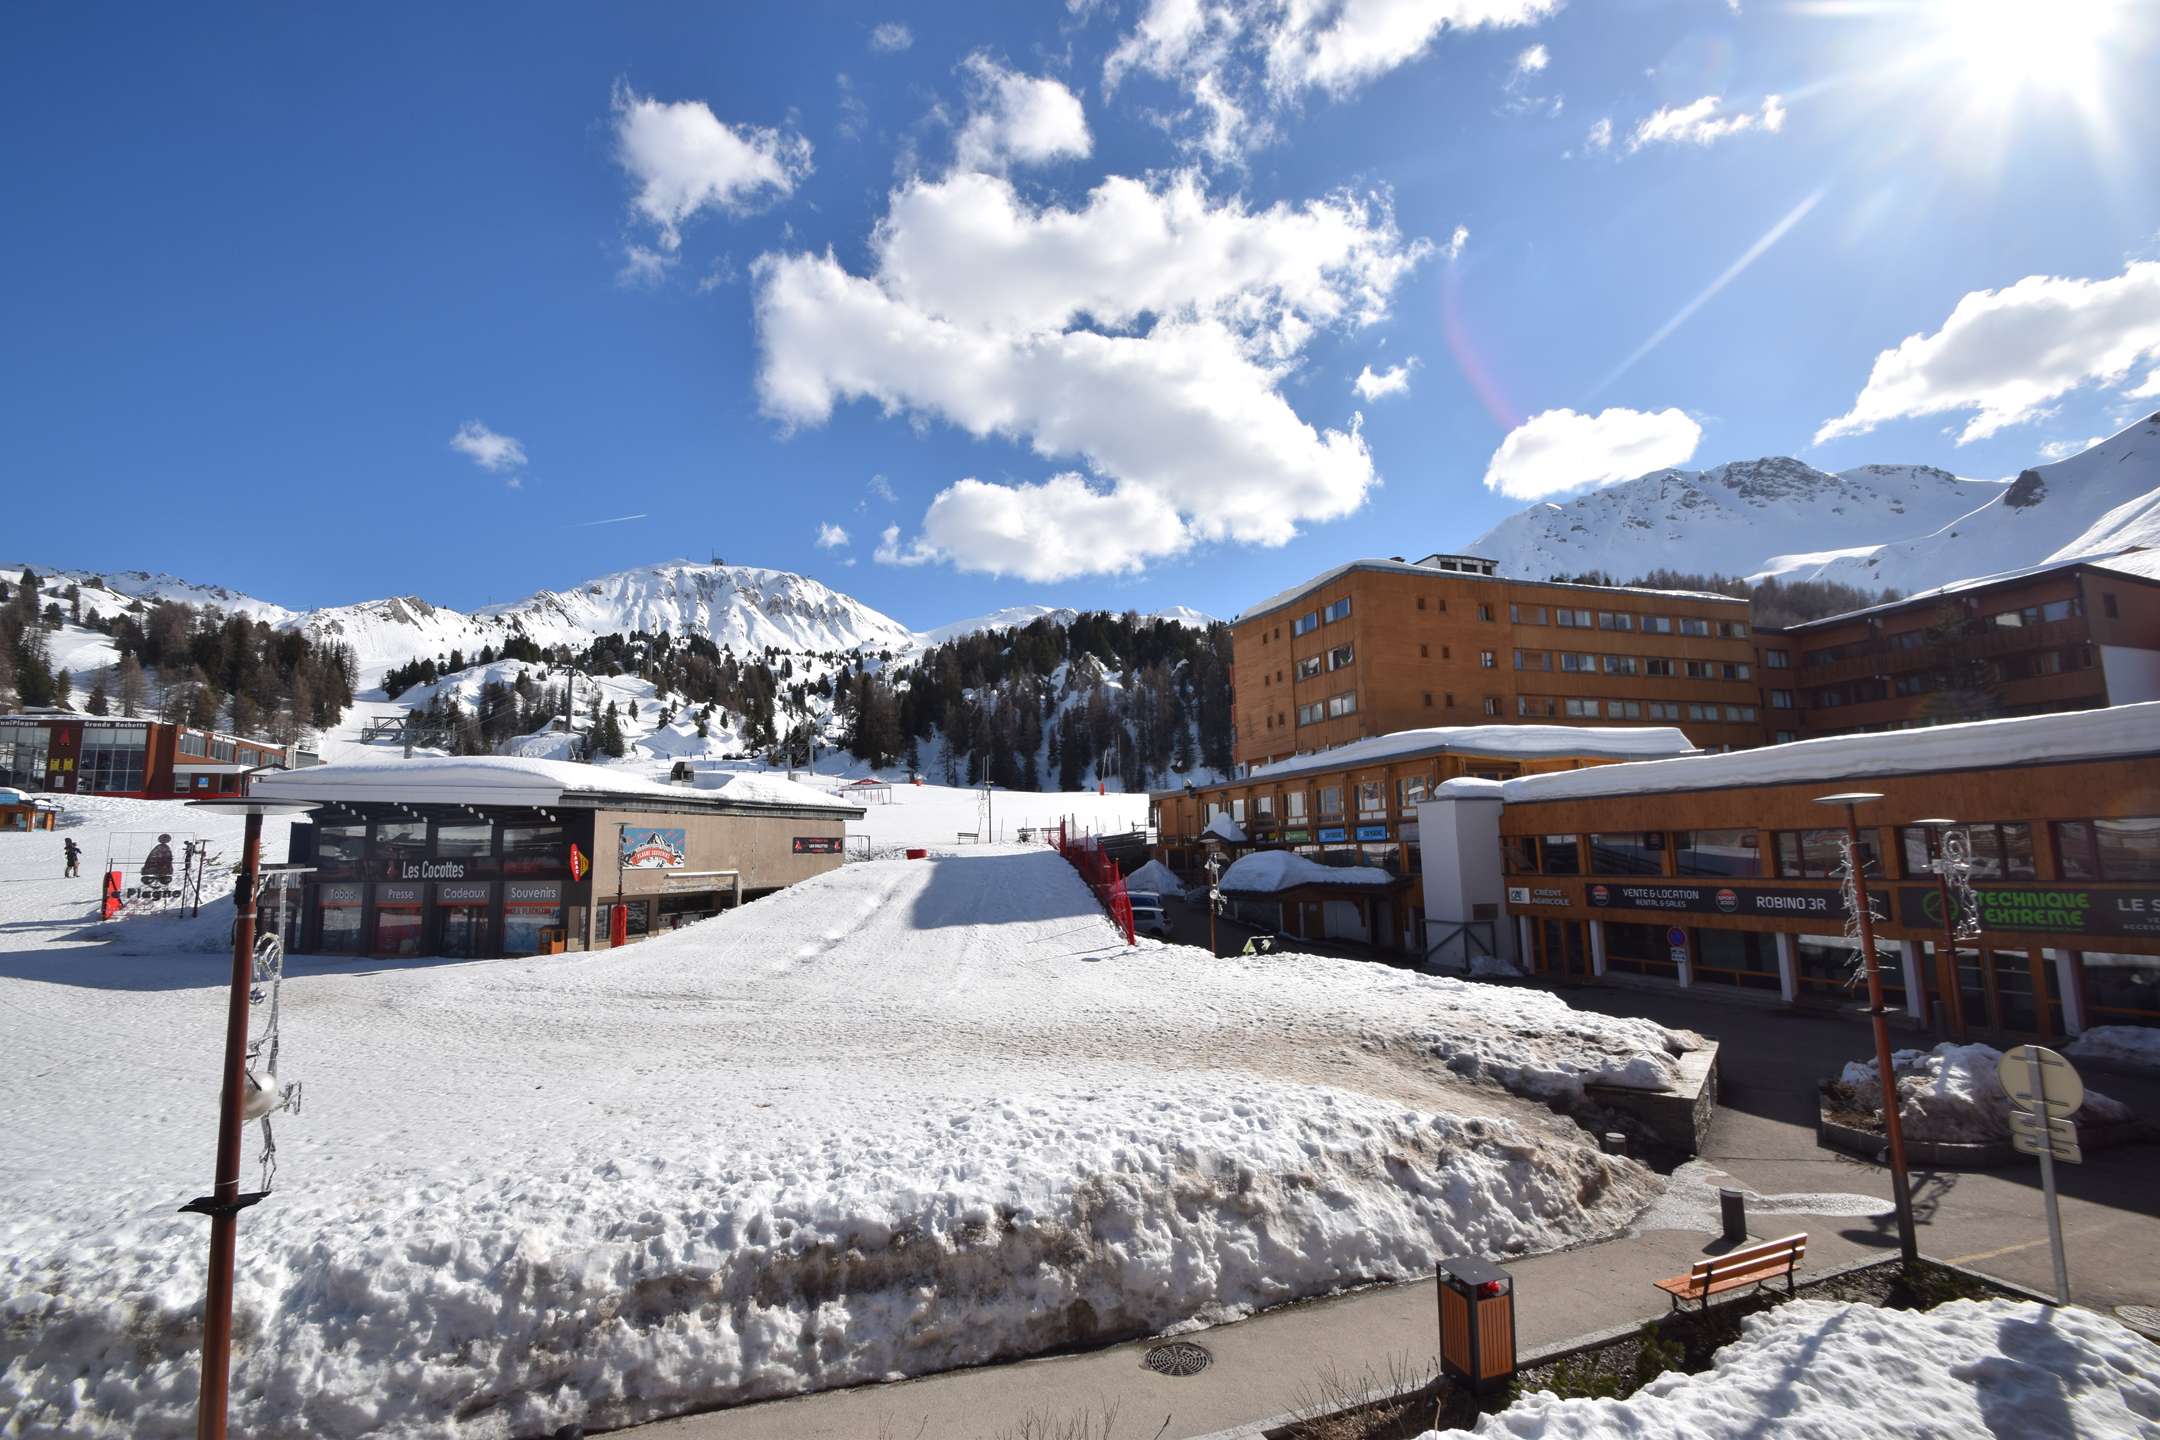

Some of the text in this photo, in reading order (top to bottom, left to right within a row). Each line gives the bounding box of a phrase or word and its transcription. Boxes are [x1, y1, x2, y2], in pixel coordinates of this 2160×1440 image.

[402, 860, 464, 879] Les Cocottes
[127, 888, 182, 901] Plagne
[330, 888, 355, 899] Tabac
[387, 888, 415, 900] Presse
[443, 887, 486, 898] Cadeaux
[511, 887, 557, 899] Souvenirs
[1622, 888, 1648, 897] VENTE
[1657, 889, 1699, 900] LOCATION
[1756, 896, 1827, 911] ROBINO 3R
[1977, 891, 2091, 909] TECHNIQUE
[2117, 898, 2145, 911] LE
[1984, 908, 2086, 926] EXTREME
